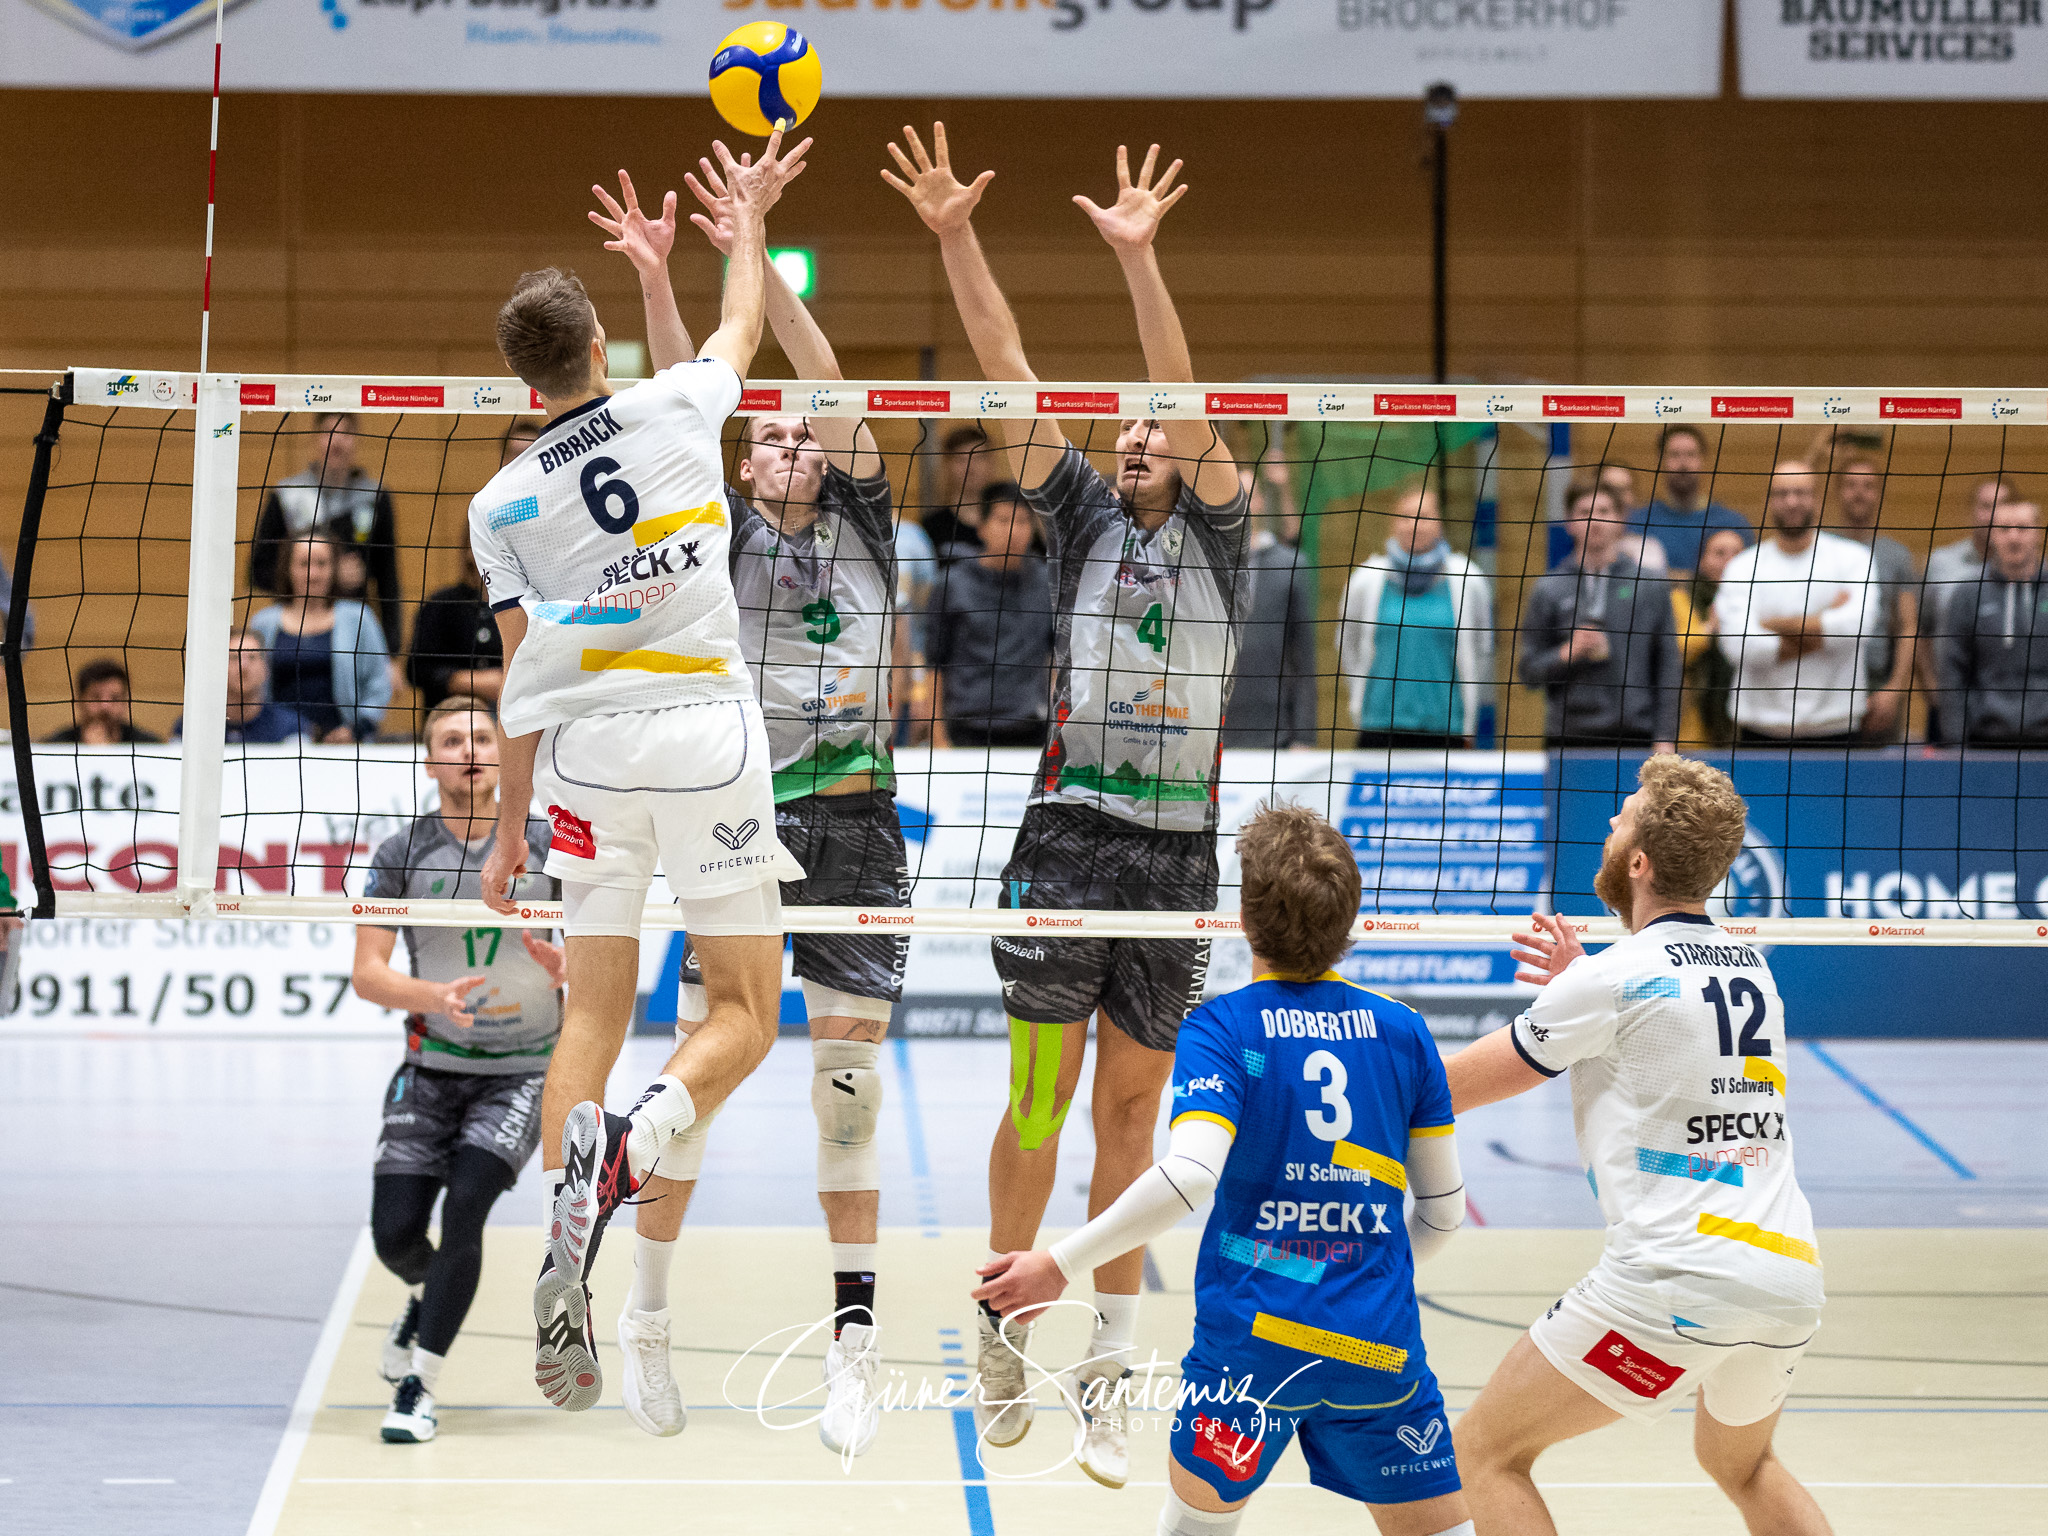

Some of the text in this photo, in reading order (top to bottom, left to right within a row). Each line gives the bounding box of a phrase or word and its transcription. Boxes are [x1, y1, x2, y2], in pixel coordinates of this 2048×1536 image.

[1808, 31, 2014, 62] SERVICES
[106, 383, 138, 393] HUCK
[312, 394, 331, 403] Zapf
[378, 394, 439, 404] Sparkasse Nürnberg
[481, 396, 500, 405] Zapf
[819, 399, 838, 408] Zapf
[884, 398, 945, 408] Sparkasse Nürnberg
[988, 400, 1007, 409] Zapf
[1053, 400, 1084, 409] Sparkasse
[1157, 402, 1176, 411] Zapf
[1222, 401, 1283, 411] Sparkasse Nürnberg
[1326, 403, 1345, 412] Zapf
[1390, 402, 1451, 412] Sparkasse Nürnberg
[1494, 404, 1513, 413] Zapf
[1559, 404, 1620, 414] Sparkasse Nürnberg
[1663, 404, 1682, 413] Zapf
[1832, 405, 1851, 414] Zapf
[1728, 405, 1789, 415] Sparkasse Nürnberg
[1896, 406, 1957, 416] Sparkasse Nürnberg
[2000, 406, 2019, 415] Zapf
[538, 408, 624, 475] BIBRACK
[580, 456, 640, 534] 6
[584, 547, 675, 603] PECK
[571, 582, 676, 624] pumpen
[801, 598, 841, 644] 9
[1136, 603, 1167, 653] 4
[1109, 701, 1190, 720] GEOTHERMIE
[1108, 719, 1188, 736] UNTERHACHING
[699, 854, 776, 875] OFFICEWELT
[1825, 870, 2020, 919] HOME
[216, 902, 240, 911] rmot
[365, 905, 409, 915] Marmot
[870, 914, 914, 924] Marmot
[1039, 917, 1083, 927] Marmot
[1376, 921, 1420, 931] Marmot
[1719, 925, 1757, 934] armot
[1881, 926, 1925, 936] Marmot
[154, 917, 299, 949] Straße
[308, 919, 335, 949] 6
[462, 927, 503, 968] 17
[992, 935, 1046, 962] ncotech
[1701, 976, 1773, 1057] 12
[1260, 1007, 1378, 1042] DOBBERTIN
[1188, 1074, 1225, 1096] puls
[1711, 1077, 1774, 1096] SV Schwaig
[1302, 1049, 1353, 1142] 3
[1687, 1112, 1768, 1145] SPECK
[1687, 1146, 1769, 1178] pumpen
[1285, 1163, 1371, 1186] SV Schwaig
[1255, 1200, 1365, 1234] SPECK
[1253, 1238, 1363, 1269] pumpen
